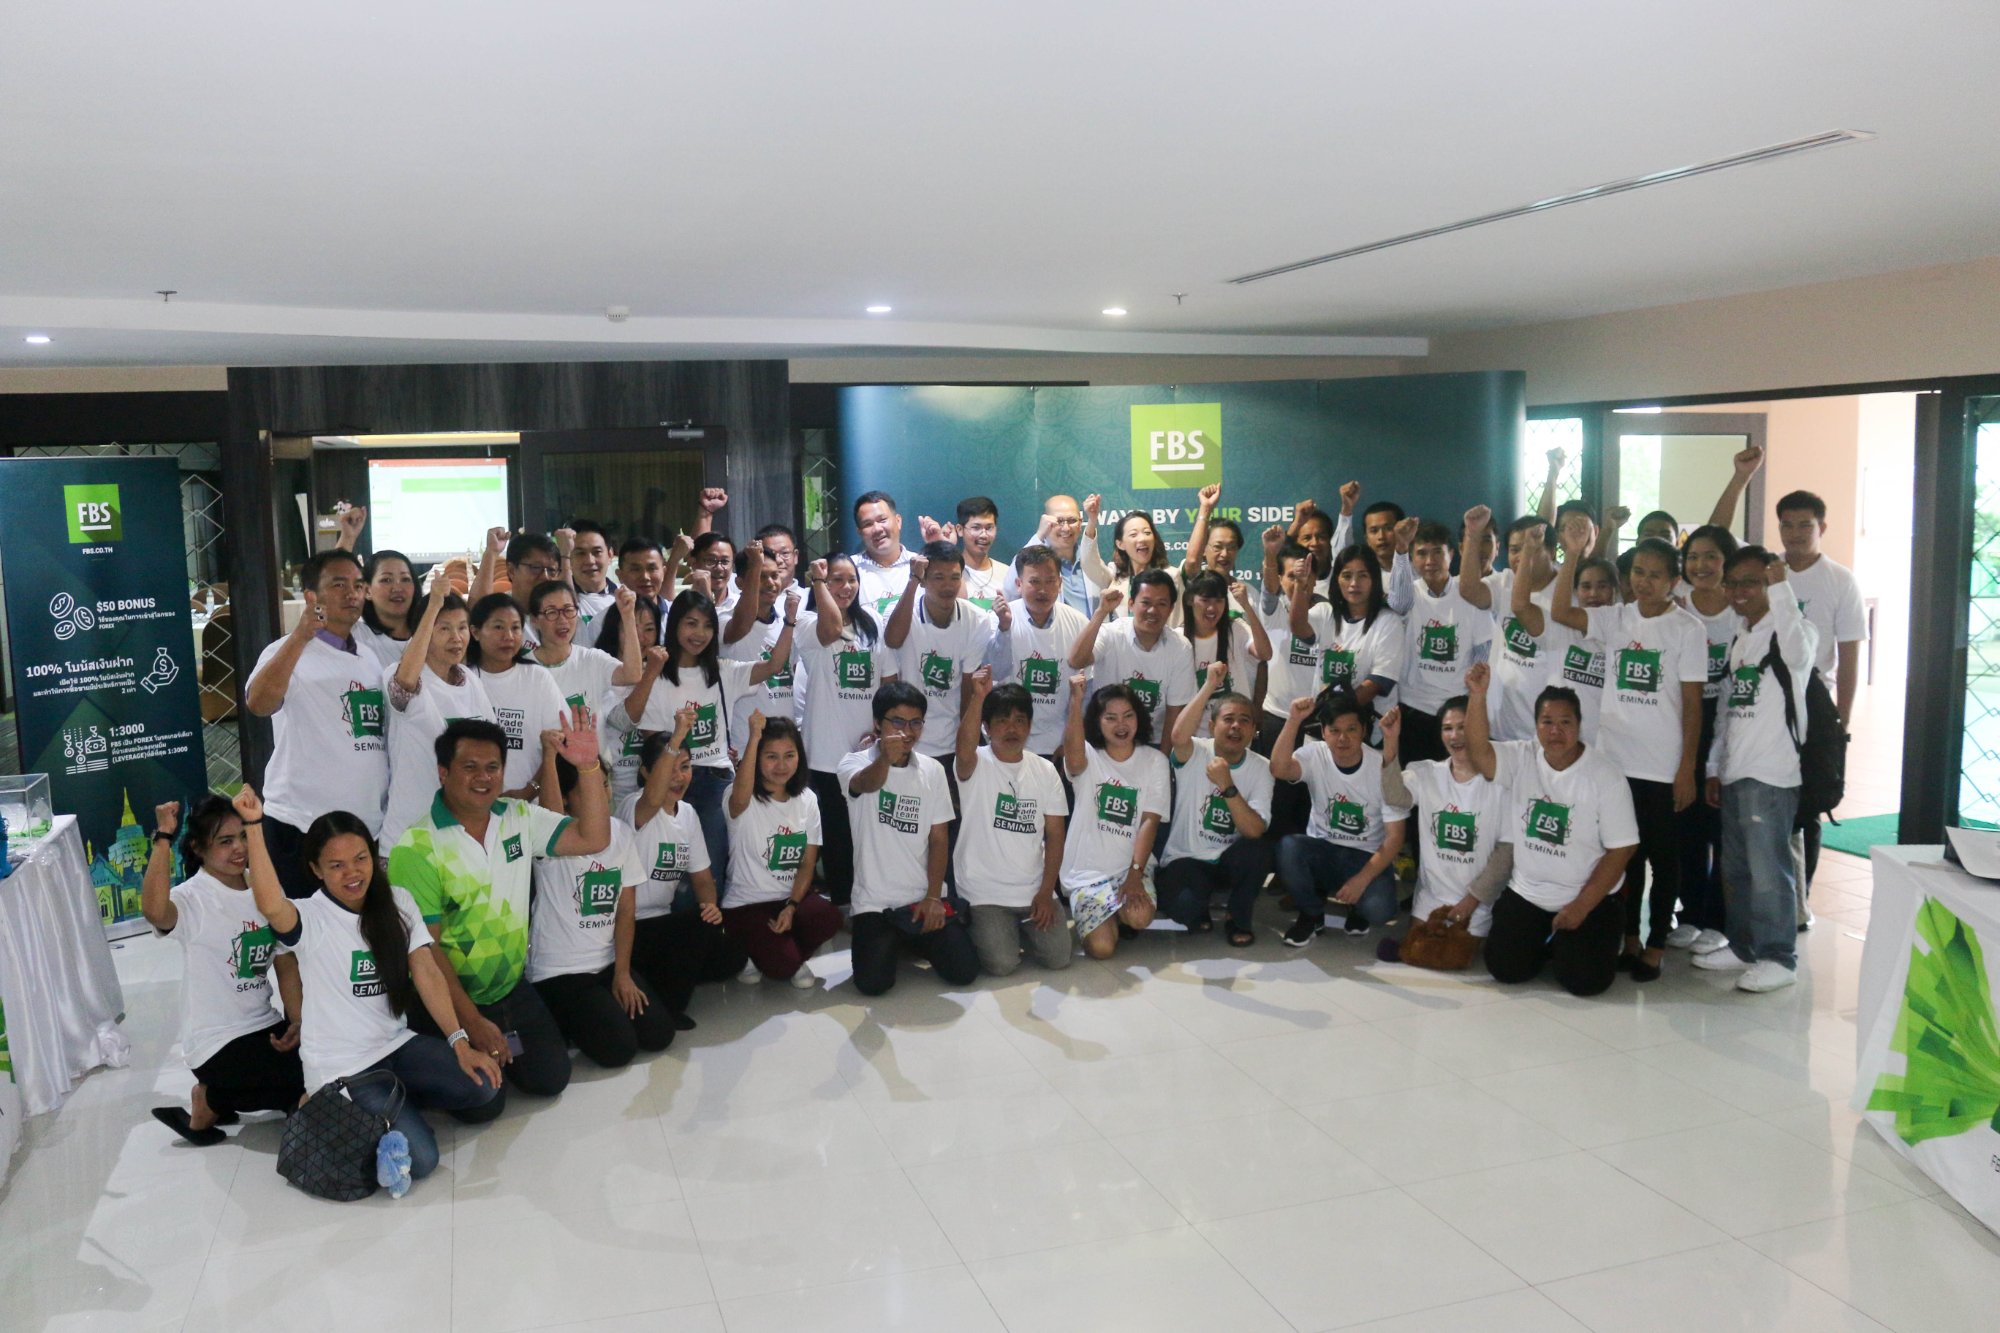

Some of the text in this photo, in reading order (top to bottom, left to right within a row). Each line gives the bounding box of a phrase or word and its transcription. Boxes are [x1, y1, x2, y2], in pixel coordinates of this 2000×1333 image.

[1150, 430, 1204, 460] FBS
[77, 502, 111, 523] FBS
[1153, 508, 1179, 524] BY
[1185, 507, 1242, 523] YUR
[1247, 506, 1294, 522] SIDE
[82, 547, 113, 555] FBS.CO.TH
[96, 597, 156, 613] $50 BONUS
[1430, 637, 1448, 650] FBS
[26, 656, 134, 678] 100% โบนัสเงินฝาก
[1291, 655, 1317, 665] SEMIN
[847, 663, 866, 676] FBS
[1329, 661, 1349, 675] FBS
[1418, 662, 1455, 673] SEMINAR
[1626, 661, 1651, 678] FBS
[79, 675, 99, 684] 100%
[1031, 669, 1051, 683] FBS
[1564, 670, 1603, 687] SEMINA
[838, 692, 873, 700] SEMINAR
[1134, 689, 1151, 702] BS
[359, 704, 379, 720] FBS
[109, 723, 145, 737] 1:3000
[691, 719, 712, 735] FBS
[134, 736, 153, 745] FOREX
[167, 745, 189, 756] 1:3000
[691, 748, 721, 760] EMINAR
[898, 804, 919, 812] trade
[1105, 796, 1129, 813] FBS
[1212, 807, 1231, 823] FBS
[1338, 811, 1358, 825] FBS
[995, 818, 1036, 833] SEMINAR
[1537, 813, 1559, 832] FBS
[1097, 822, 1132, 838] SEMINAR
[1328, 832, 1368, 842] SEMINAR
[1444, 823, 1467, 839] FBS
[509, 841, 520, 854] FBS
[780, 846, 802, 860] FBS
[1436, 852, 1475, 864] SEMINAR
[591, 884, 614, 900] FBS
[357, 959, 376, 971] FBS
